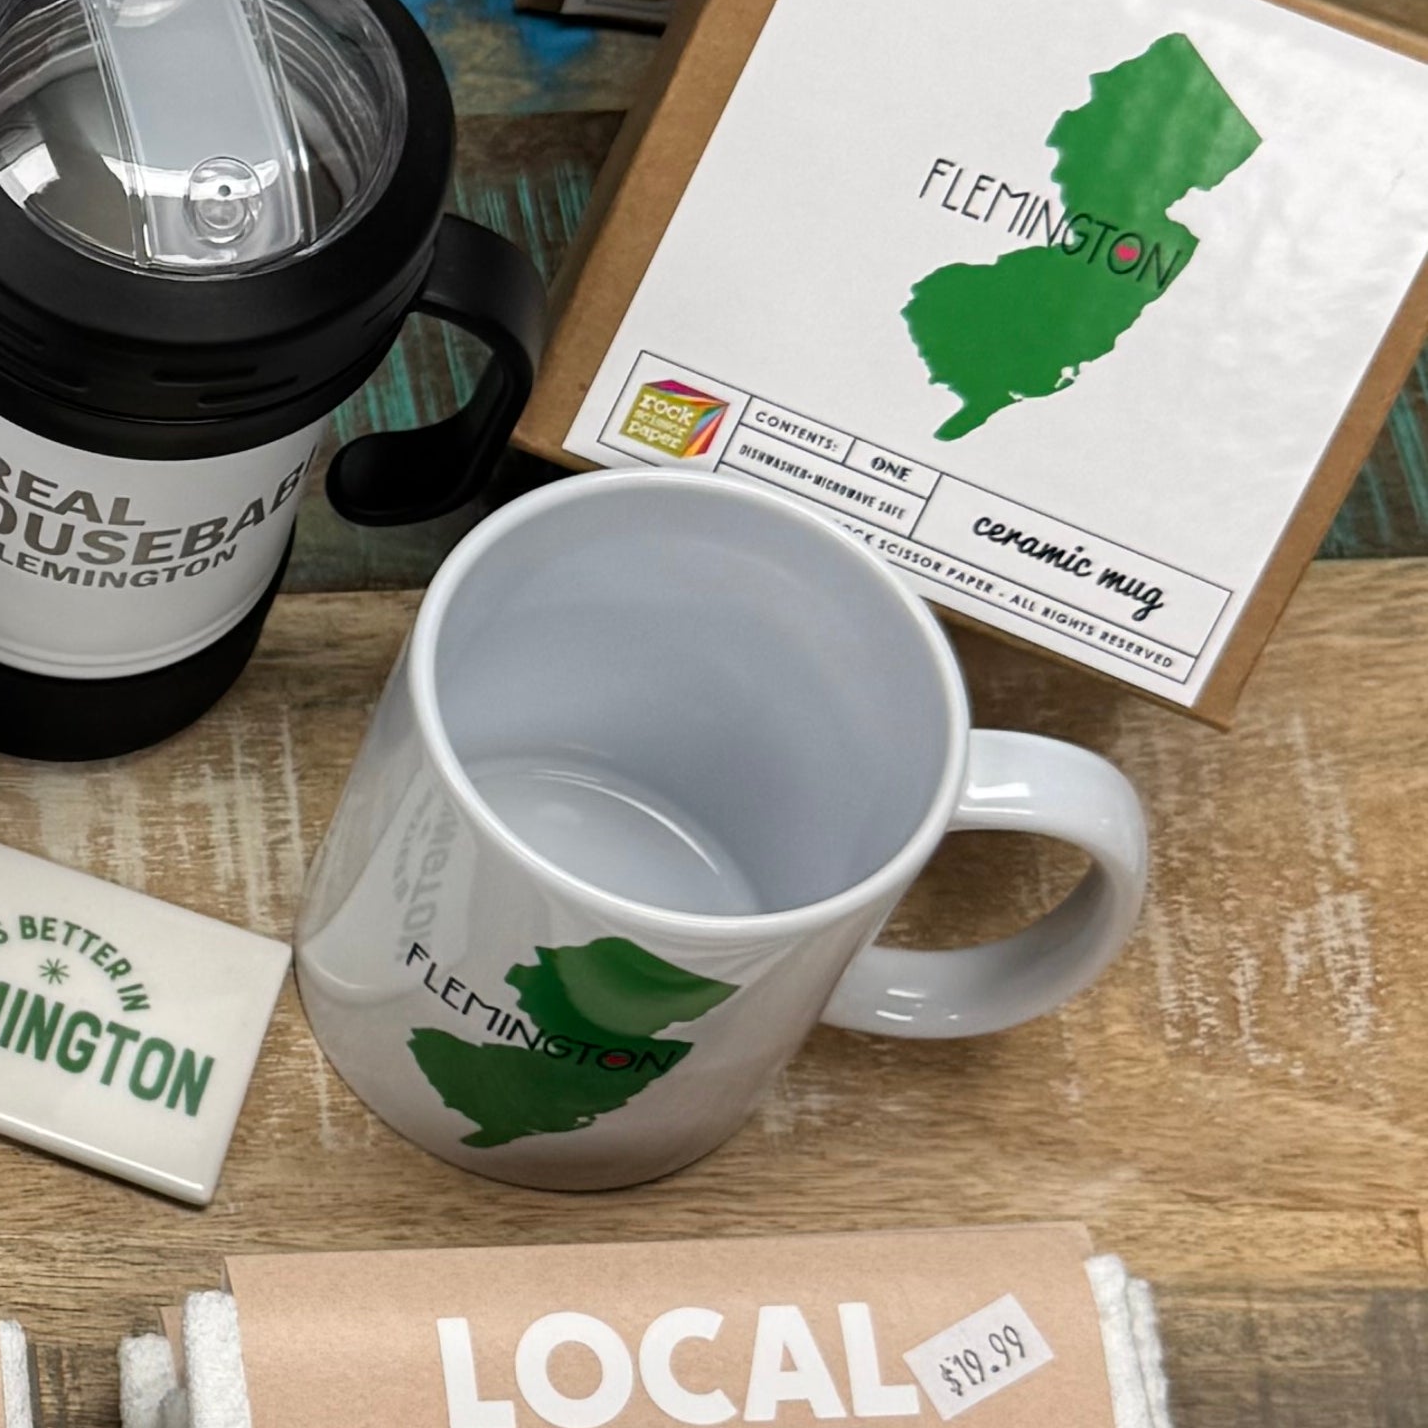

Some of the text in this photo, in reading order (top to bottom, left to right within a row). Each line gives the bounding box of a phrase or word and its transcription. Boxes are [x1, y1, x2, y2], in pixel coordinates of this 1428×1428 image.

[919, 157, 1183, 292] FLEMINGTON
[870, 456, 913, 483] ONE
[877, 500, 907, 521] SAFE
[877, 539, 1174, 671] SCISSOR PAPER ALL RIGHTS RESERVED
[972, 515, 1165, 622] ceramic mug
[17, 913, 133, 983] BETTER
[116, 981, 152, 1013] IN
[405, 940, 678, 1074] FLEMINGTON
[940, 1322, 1026, 1398] $19.99
